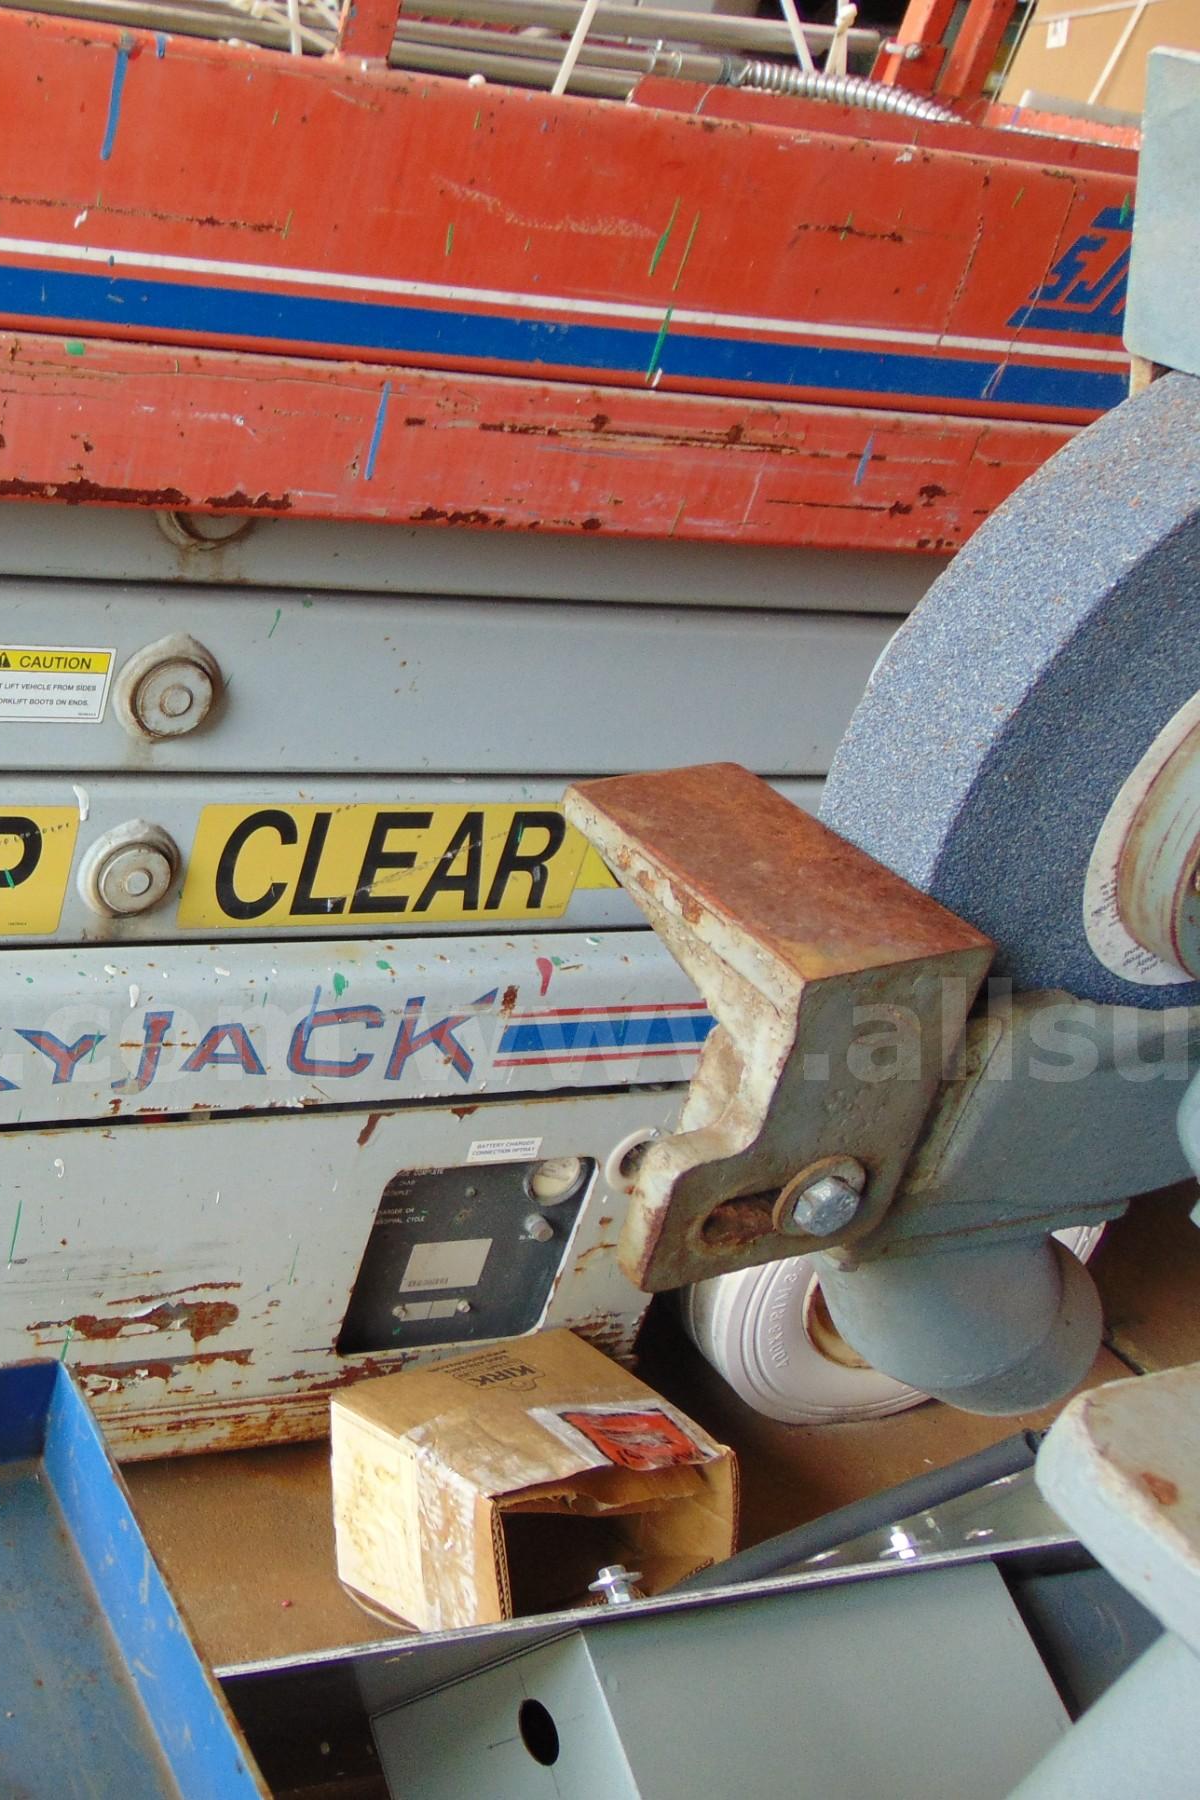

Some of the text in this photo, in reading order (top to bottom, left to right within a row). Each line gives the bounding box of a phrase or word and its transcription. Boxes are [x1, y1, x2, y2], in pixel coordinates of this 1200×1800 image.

[19, 655, 92, 670] CAUTION
[21, 683, 51, 691] VEHICLE
[29, 698, 55, 706] BOOTS
[214, 809, 568, 920] CLEAR
[467, 1364, 536, 1387] KIRK
